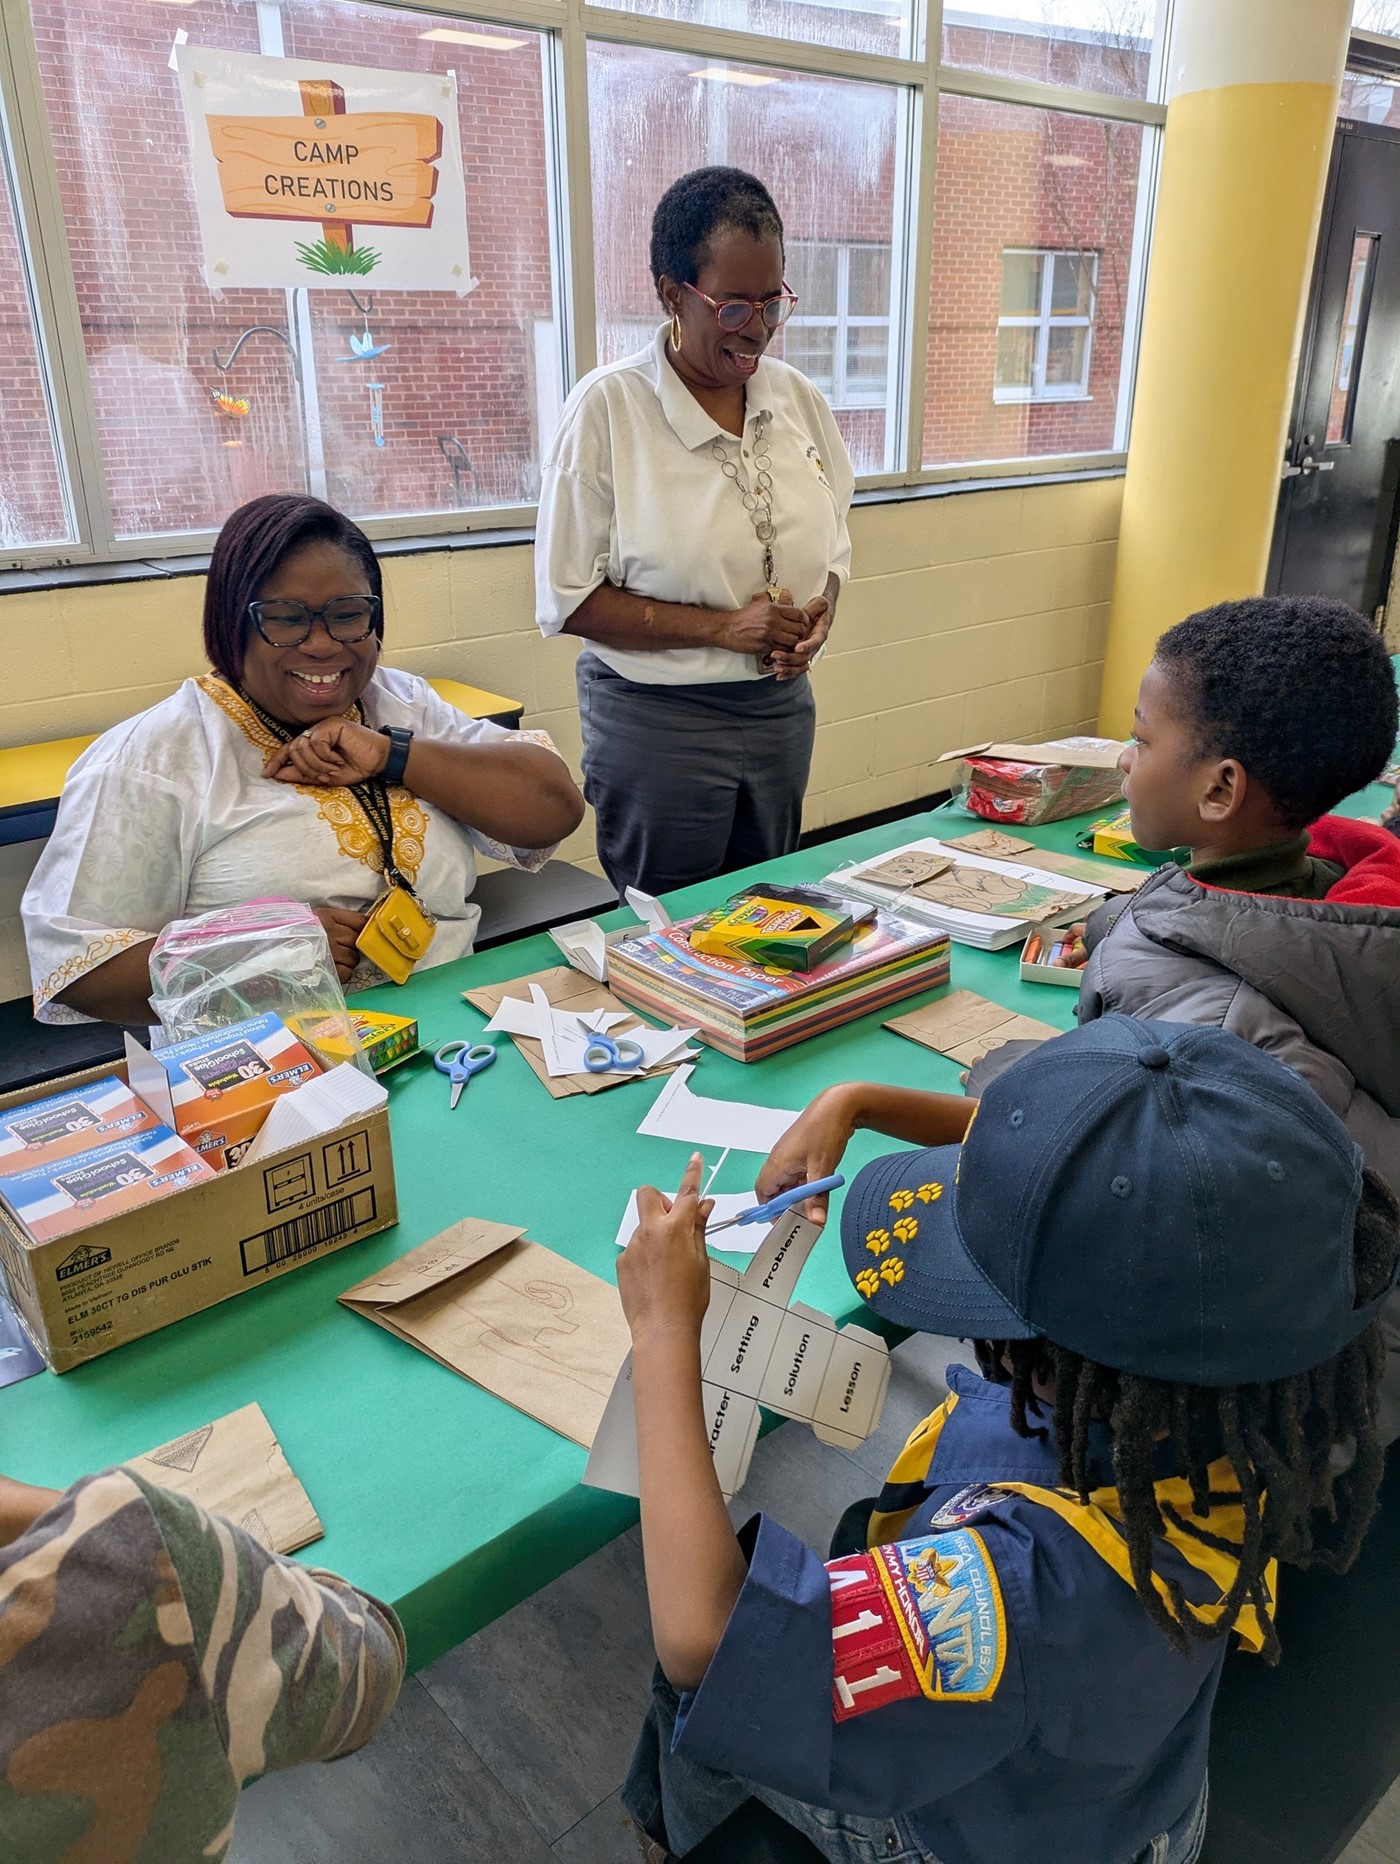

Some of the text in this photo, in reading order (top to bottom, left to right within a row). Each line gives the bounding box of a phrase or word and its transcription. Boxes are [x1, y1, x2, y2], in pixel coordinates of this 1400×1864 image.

[294, 141, 359, 164] CAMP
[264, 174, 393, 201] CREATIONS
[736, 966, 784, 985] Paper
[193, 1048, 246, 1072] School Glue
[207, 1059, 265, 1088] 30 Washable
[270, 1064, 309, 1083] ELMER'S
[65, 1115, 94, 1132] 30
[99, 1113, 142, 1132] ELMER'S
[66, 1158, 127, 1185] School Glue
[80, 1167, 146, 1198] 30 Washable
[152, 1165, 198, 1186] ELMER'S
[306, 1188, 344, 1208] units/case
[60, 1238, 180, 1291] PRODUCT OF NEWELL OFFICE BRANDS
[60, 1253, 106, 1278] ELMER'S
[77, 1271, 115, 1290] PEACHTREE
[118, 1254, 154, 1274] DUNWOODY
[166, 1246, 174, 1254] NE
[277, 1260, 286, 1268] 00
[762, 1224, 802, 1290] Problem
[62, 1286, 93, 1303] ATLANTA,
[95, 1281, 104, 1289] GA
[64, 1303, 81, 1313] Made
[88, 1290, 112, 1303] Vietnam
[68, 1257, 212, 1325] ELM 30CT 7G DIS PUR GLU STIK
[730, 1314, 760, 1375] Setting
[783, 1332, 810, 1397] Solution
[839, 1361, 862, 1414] Lesson
[709, 1390, 731, 1455] racter
[884, 1554, 903, 1579] MY
[896, 1578, 926, 1657] HONOR
[968, 1568, 992, 1643] COUNCIL
[978, 1645, 992, 1681] BSA
